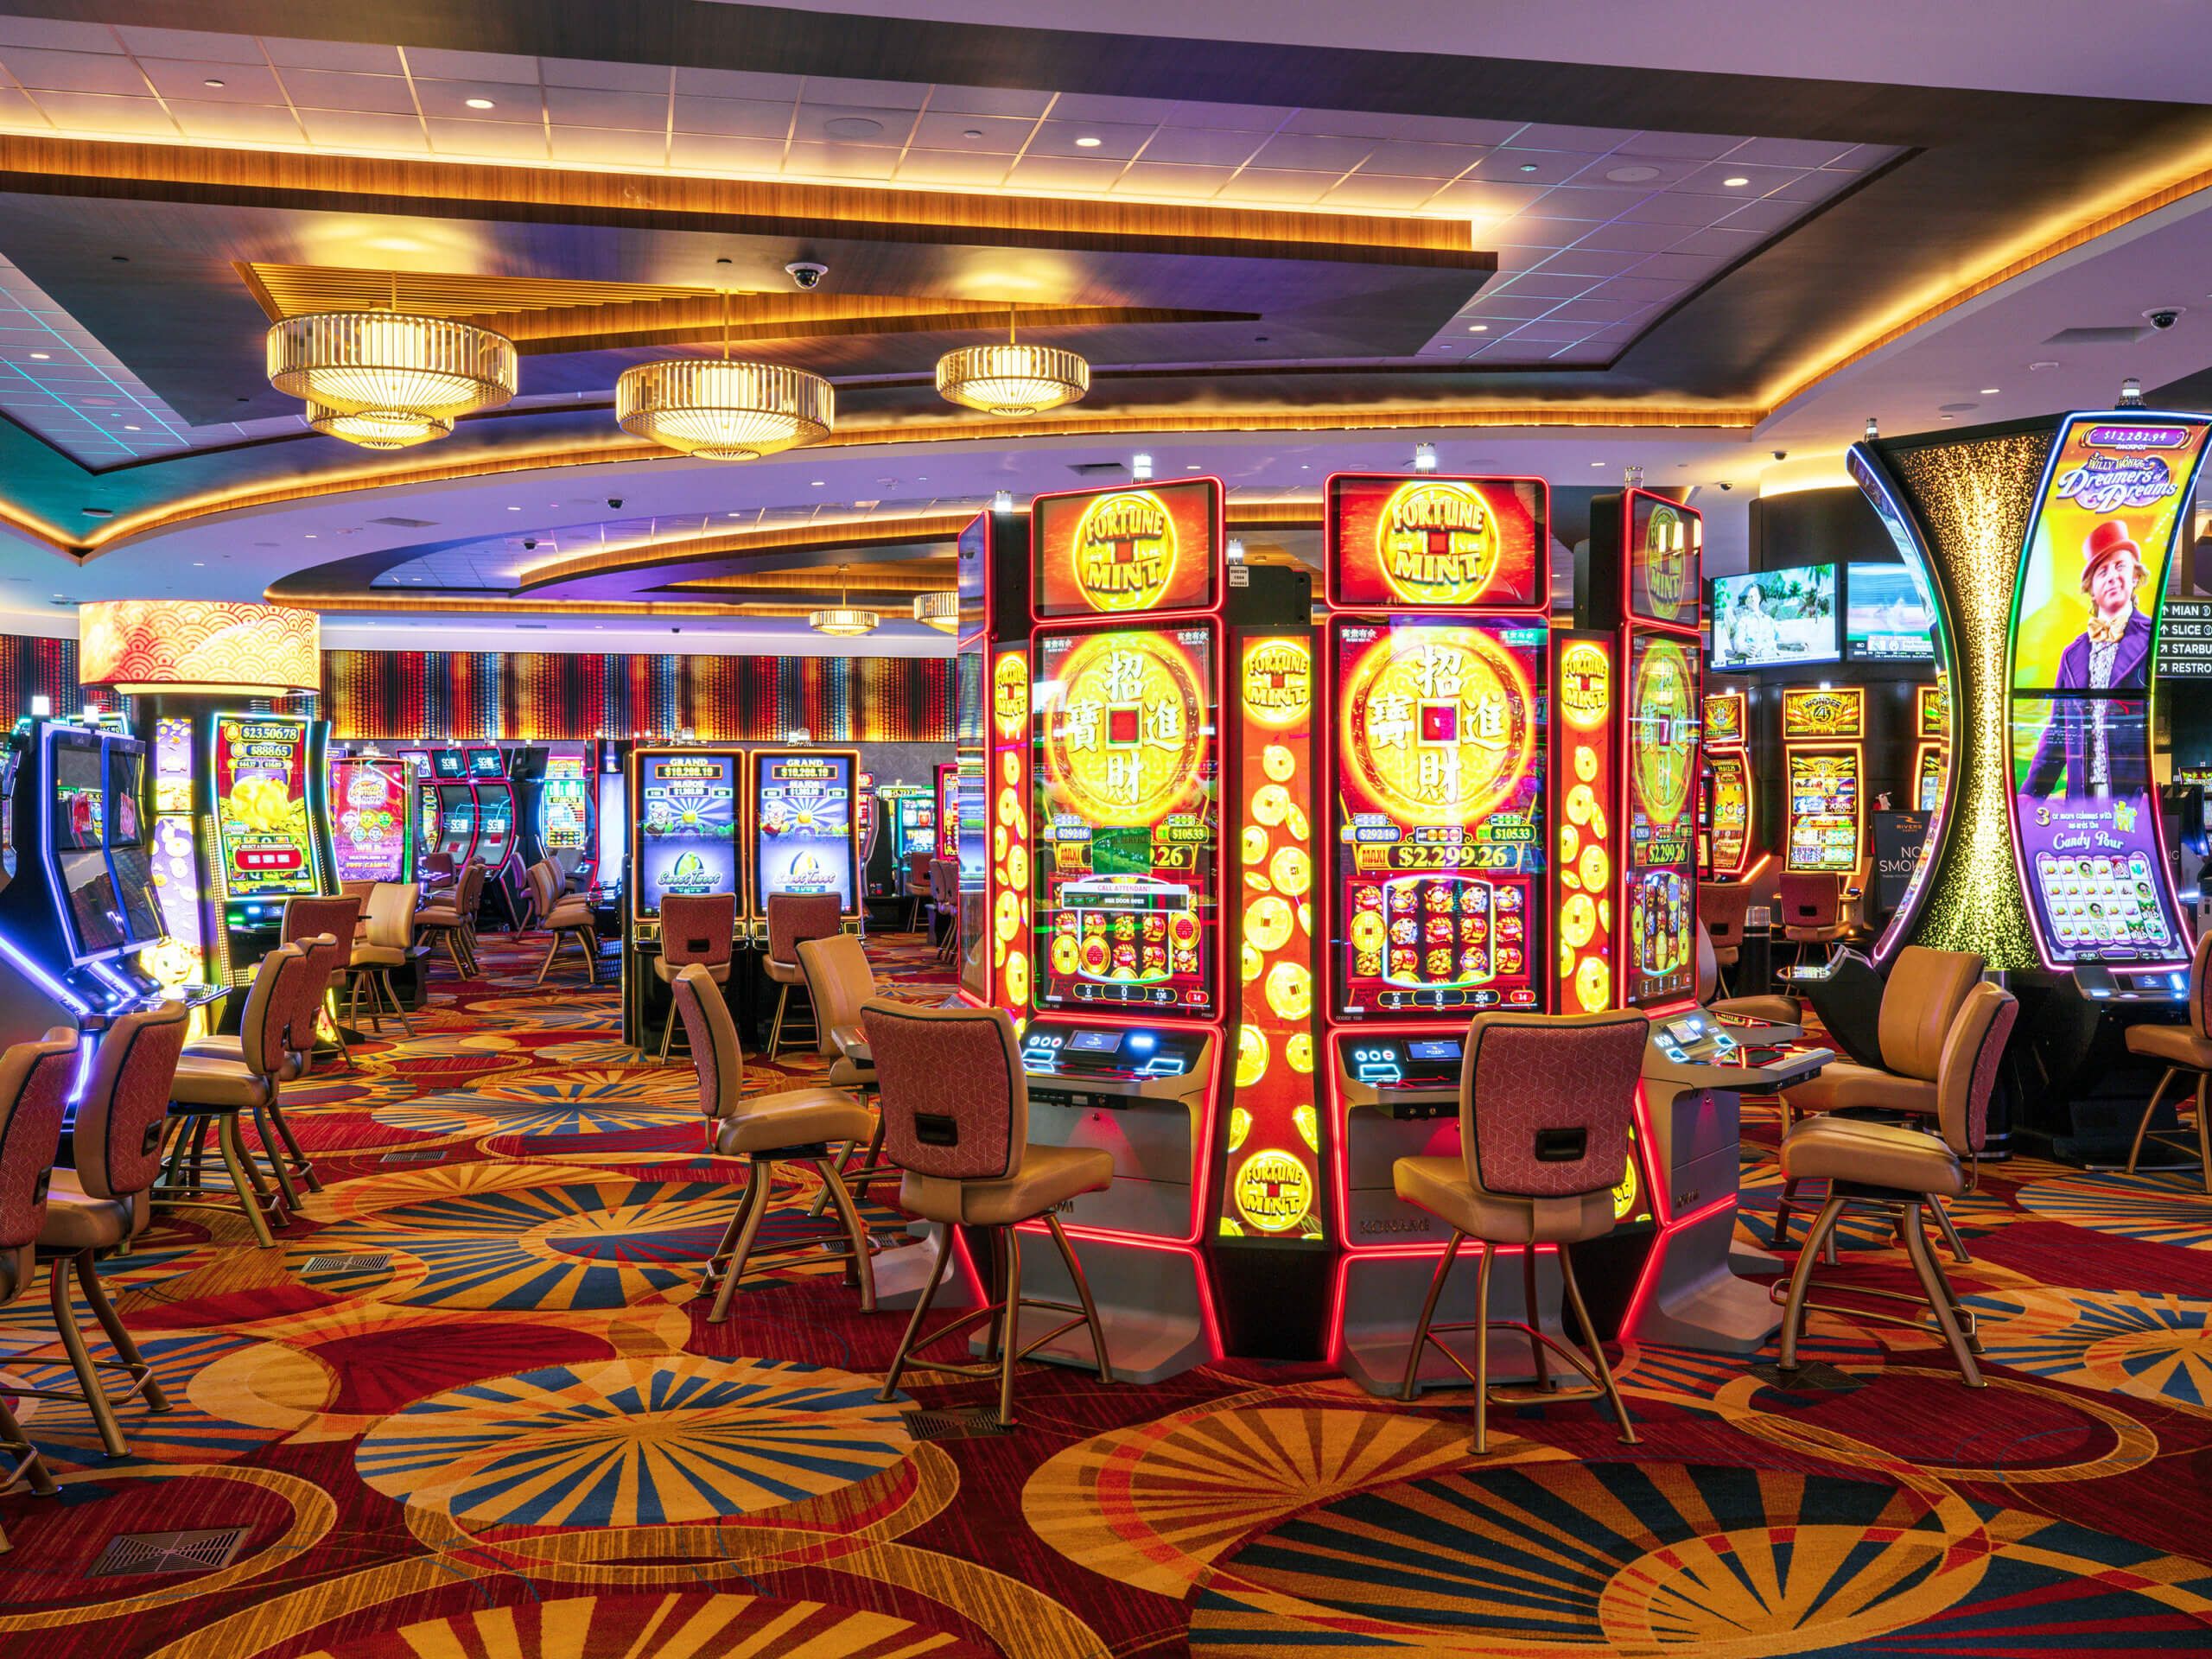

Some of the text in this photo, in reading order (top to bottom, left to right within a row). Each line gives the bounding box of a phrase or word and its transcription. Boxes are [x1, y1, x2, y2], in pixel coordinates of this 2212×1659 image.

[2104, 431, 2167, 442] $12,282.94
[2088, 458, 2114, 470] WILLY
[2056, 469, 2152, 499] Dreamers
[2092, 483, 2177, 513] Dreams
[1393, 499, 1484, 531] FORTUNE
[1085, 509, 1164, 543] FORTUNE
[1087, 557, 1161, 591] MINT
[1395, 551, 1481, 582] MINT
[2171, 606, 2199, 616] MIAN
[2171, 625, 2201, 635] SLICE
[1248, 656, 1308, 675] FORTUNE
[1563, 659, 1606, 678] FORTUNE
[1103, 651, 1144, 702] 招
[1250, 686, 1306, 707] MINT
[1566, 688, 1605, 709] MINT
[1803, 697, 1842, 709] WONDER
[1815, 706, 1829, 721] 4
[2036, 807, 2050, 826] 3
[2053, 830, 2124, 849] Candy Pour
[1363, 847, 1507, 867] MAXI $2,299.26
[1901, 846, 1922, 858] NO
[658, 871, 690, 885] Sweet
[1122, 988, 1127, 997] 0
[1435, 993, 1442, 1002] 0
[1246, 1166, 1302, 1185] FORTUNE
[1246, 1195, 1300, 1215] MINT
